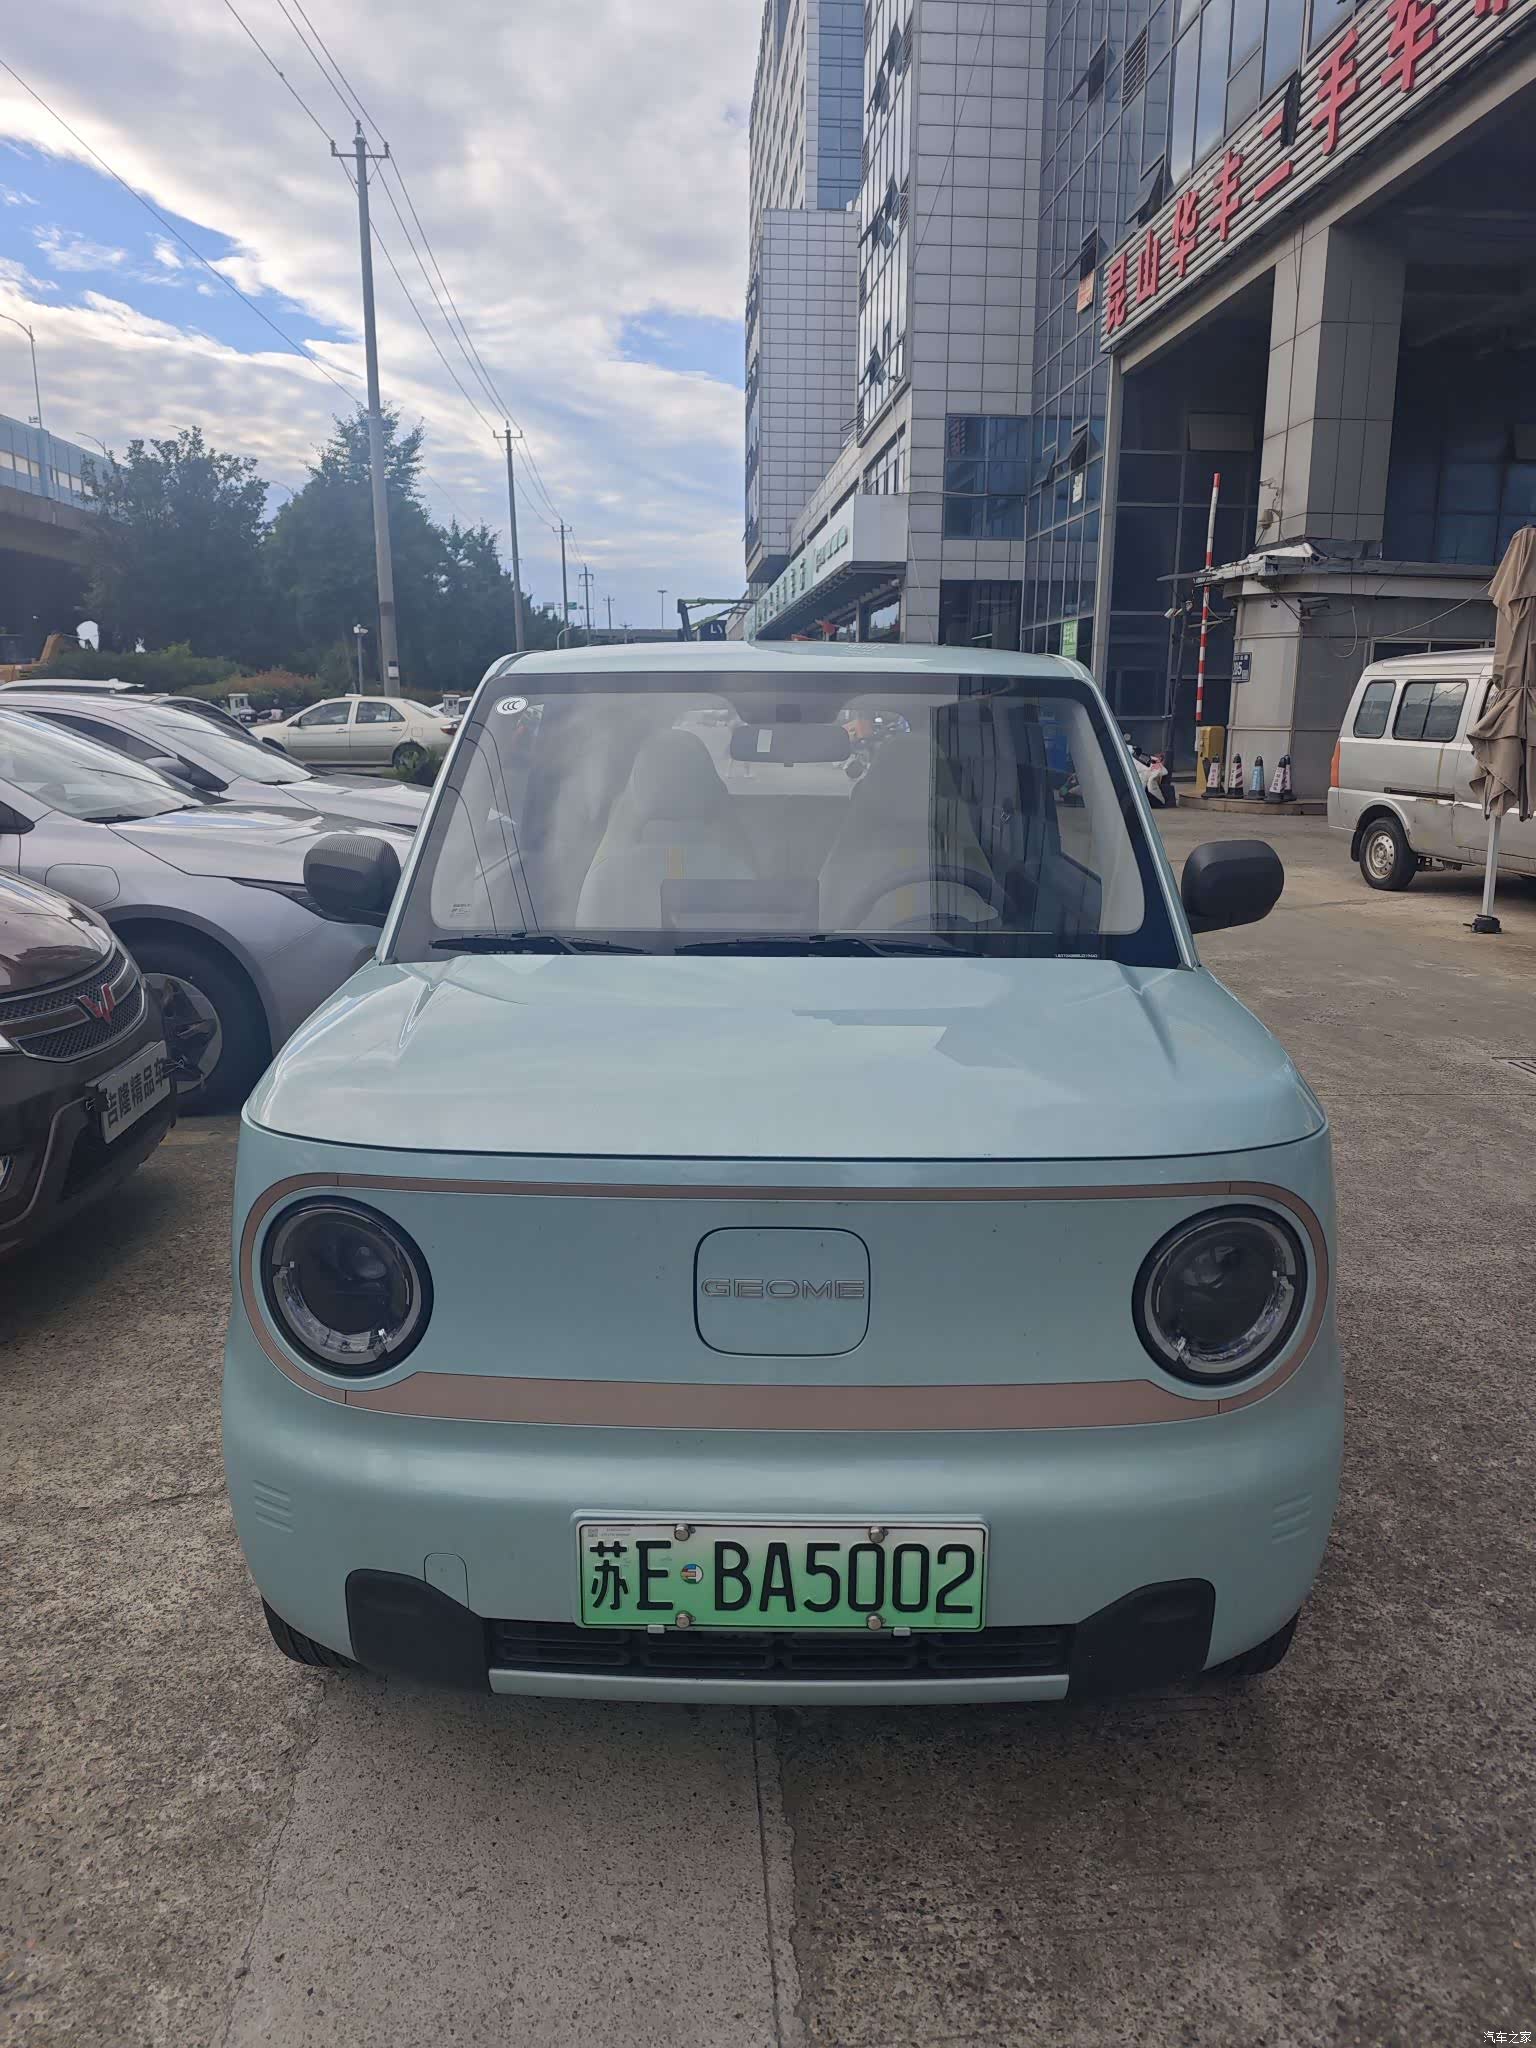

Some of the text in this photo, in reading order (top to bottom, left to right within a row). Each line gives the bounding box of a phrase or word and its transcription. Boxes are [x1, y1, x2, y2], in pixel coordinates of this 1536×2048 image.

[1105, 0, 1509, 335] 昆山华丰二手车
[701, 1278, 865, 1299] GEOME
[714, 1541, 976, 1614] BA5002
